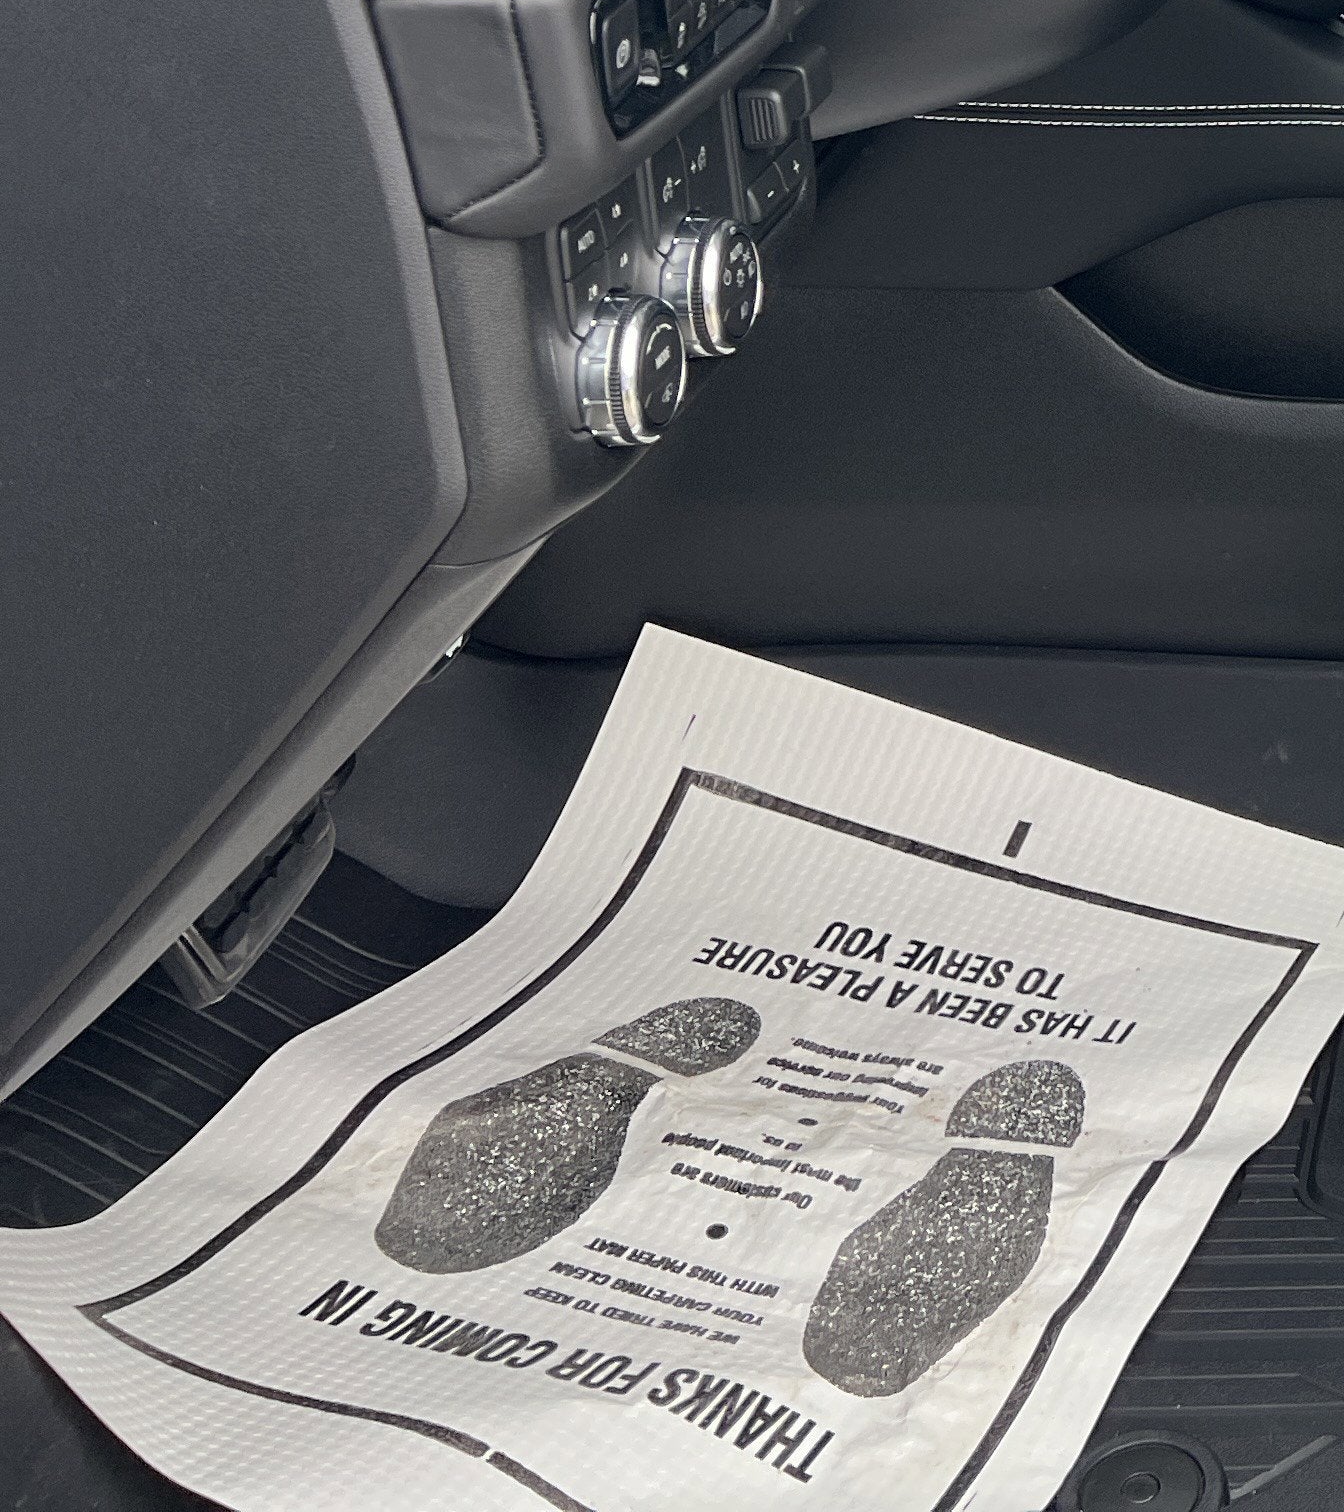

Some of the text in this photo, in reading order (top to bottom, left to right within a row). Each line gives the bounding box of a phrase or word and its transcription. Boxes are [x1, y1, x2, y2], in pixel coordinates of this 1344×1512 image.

[812, 920, 1064, 1000] TO SERVE YOU
[691, 935, 1136, 1044] IT HAS BEEN A PLEASURE
[780, 1190, 812, 1209] Our
[582, 1236, 779, 1298] WITH THIS PAPER MAT
[522, 1285, 574, 1306] KEEP
[547, 1261, 763, 1326] YOUR CARPETING CLEAN
[571, 1298, 599, 1313] TO
[599, 1305, 654, 1327] TRIED
[705, 1329, 740, 1344] WE
[298, 1278, 833, 1482] THANKS FOR COMING IN
